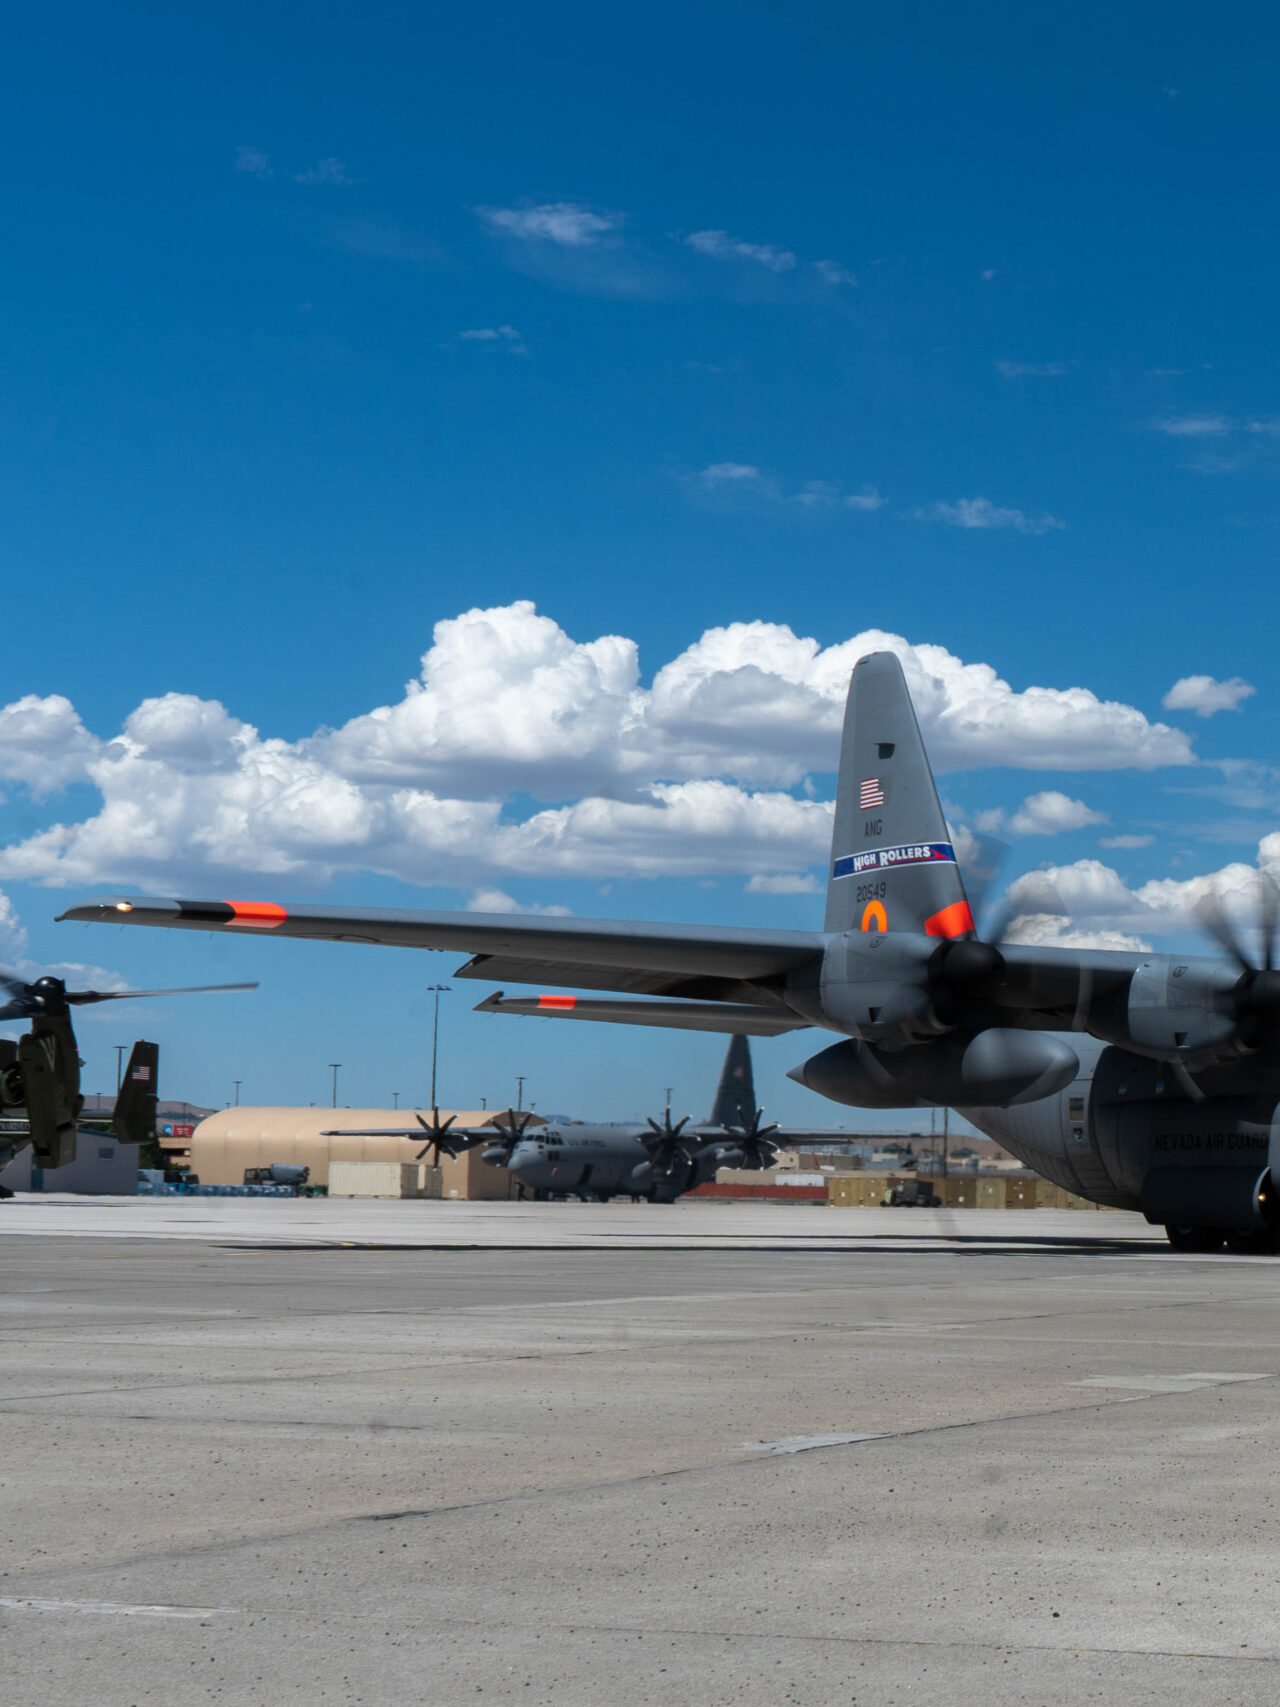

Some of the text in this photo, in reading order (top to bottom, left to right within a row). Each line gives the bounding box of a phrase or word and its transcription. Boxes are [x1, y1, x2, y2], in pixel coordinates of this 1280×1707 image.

[864, 819, 882, 838] ANG
[853, 846, 931, 872] HIGH ROLLERS
[856, 881, 887, 903] 20549
[1154, 1131, 1270, 1152] NEVADA AIR GUARD
